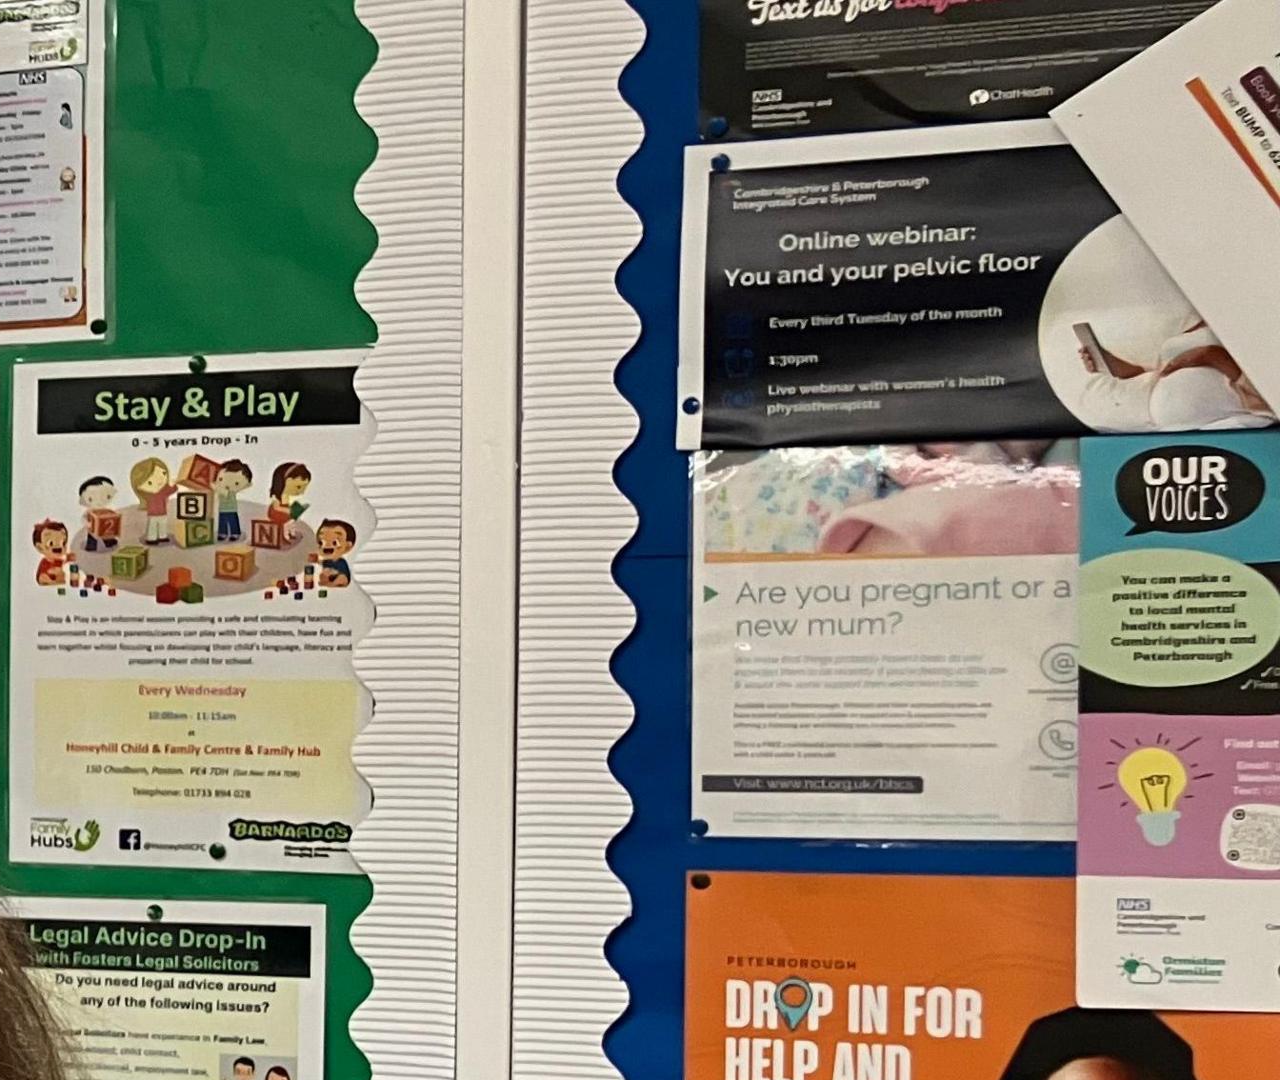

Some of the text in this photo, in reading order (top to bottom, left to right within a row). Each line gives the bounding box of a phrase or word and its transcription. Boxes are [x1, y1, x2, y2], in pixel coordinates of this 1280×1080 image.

[749, 0, 812, 25] Text
[845, 0, 890, 22] for
[20, 72, 47, 84] NHS
[991, 87, 1053, 100] ChatHealth
[1221, 87, 1240, 108] Text
[1235, 107, 1265, 138] BUMP
[734, 182, 829, 199] Cambridgeshire
[844, 176, 929, 192] Peterborough
[733, 191, 876, 212] Integrated Care System
[779, 225, 976, 252] Online webinar:
[724, 253, 1042, 288] You and your pelvic floor
[770, 306, 1002, 330] Every third Tuesday of the month
[768, 374, 1005, 396] Live webinar with women's health
[94, 384, 299, 426] Stay & Play
[767, 399, 880, 416] physiotherapists
[132, 438, 139, 447] 0
[152, 437, 160, 446] 5
[164, 437, 197, 448] years
[202, 436, 232, 447] Drop
[245, 434, 258, 443] In
[1143, 456, 1227, 486] OUR
[1121, 575, 1230, 585] You can make a
[736, 577, 1072, 609] Are you pregnant or a
[1112, 589, 1247, 602] positive difference
[1129, 604, 1235, 615] to local mental
[736, 611, 903, 636] new mum?
[1121, 620, 1246, 631] health services in
[1111, 635, 1256, 648] Cambridgeshire and
[1134, 651, 1232, 662] Peterborough
[138, 684, 246, 698] Every Wednesday
[197, 712, 236, 721] 11:15am
[66, 742, 321, 759] Honeyhill Child & Family Centre & Family Hub
[31, 822, 71, 835] Family
[31, 835, 73, 848] Hubs
[1118, 900, 1150, 910] NHS
[30, 924, 266, 953] Legal Advice Drop-In
[37, 951, 259, 972] with Fosters Legal Solicitors
[727, 956, 857, 970] PETERBOROUGH
[55, 973, 276, 992] Do you need legal advice around
[80, 994, 270, 1013] any of the following issues?
[725, 977, 982, 1039] DROP IN FOR
